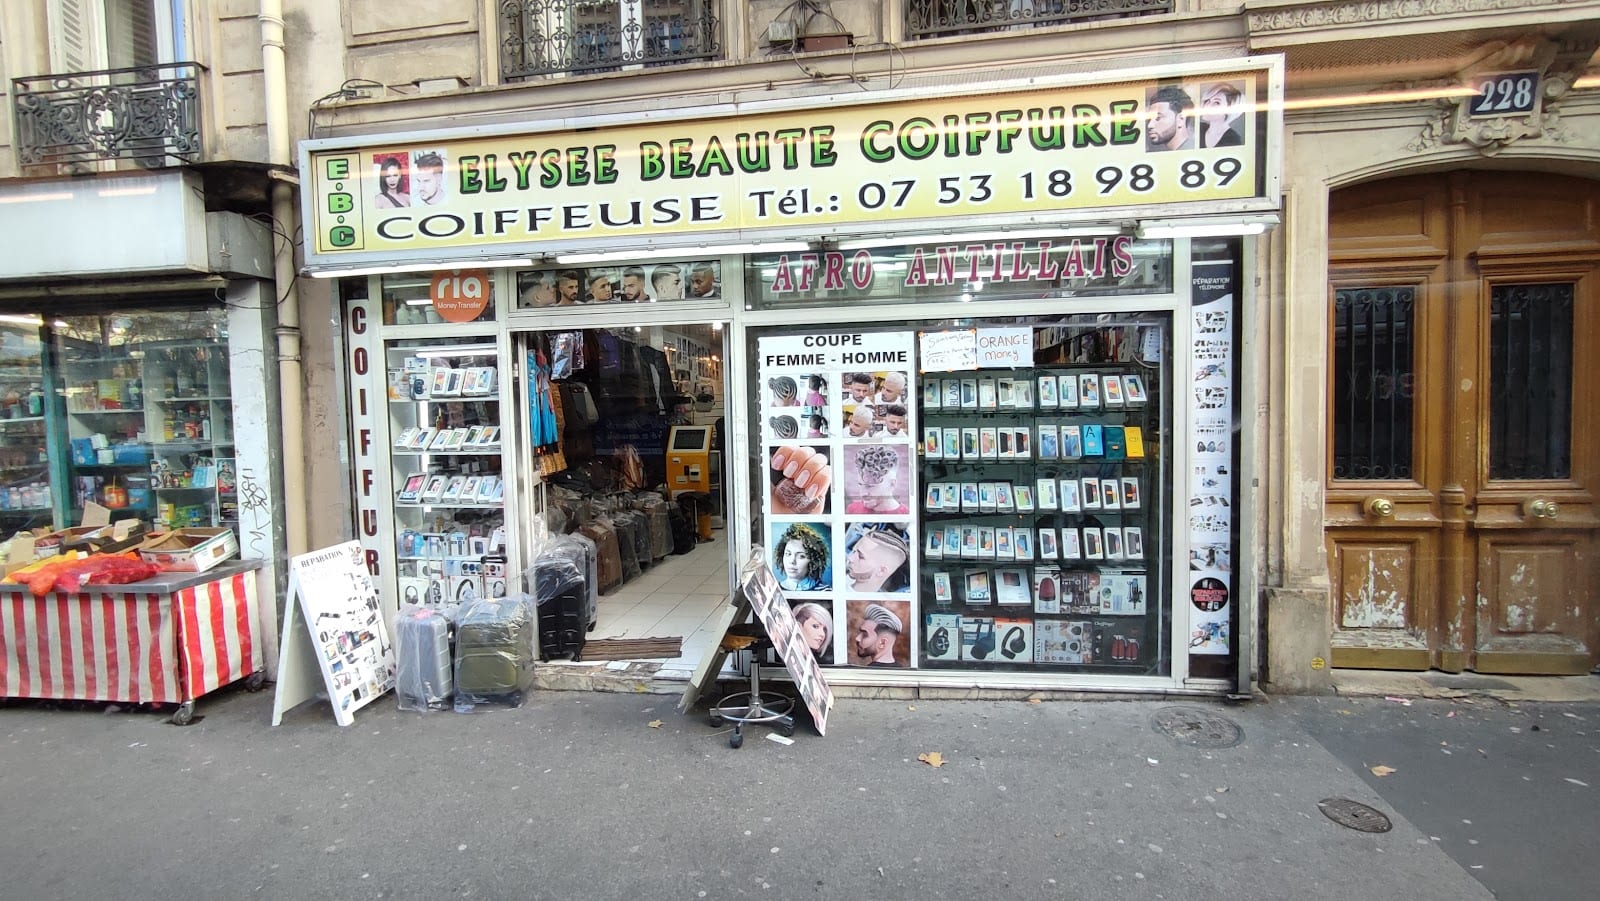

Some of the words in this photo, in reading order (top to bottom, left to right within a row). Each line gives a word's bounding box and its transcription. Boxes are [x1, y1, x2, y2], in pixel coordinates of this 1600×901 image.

[1475, 78, 1532, 111] 228
[459, 144, 618, 194] ELYSEE
[640, 126, 838, 181] BEAUTE
[860, 99, 1140, 162] COIFFURE
[377, 196, 723, 240] COIFFEUSE
[750, 190, 840, 217] Tél.:
[858, 180, 916, 209] 07
[938, 174, 993, 203] 53
[1021, 170, 1073, 199] 18
[1097, 163, 1154, 193] 98
[1180, 157, 1241, 188] 89
[772, 249, 875, 293] AFRO
[905, 235, 1136, 287] ANTILLAIS
[437, 270, 482, 299] ria
[438, 302, 457, 310] Money
[458, 301, 481, 309] Transfer
[803, 334, 863, 347] COUPE
[979, 334, 1030, 349] ORANGE
[766, 353, 826, 367] FEMME
[841, 350, 908, 365] HOMME
[352, 306, 380, 603] COIFFUR
[301, 550, 343, 568] REPARATION
